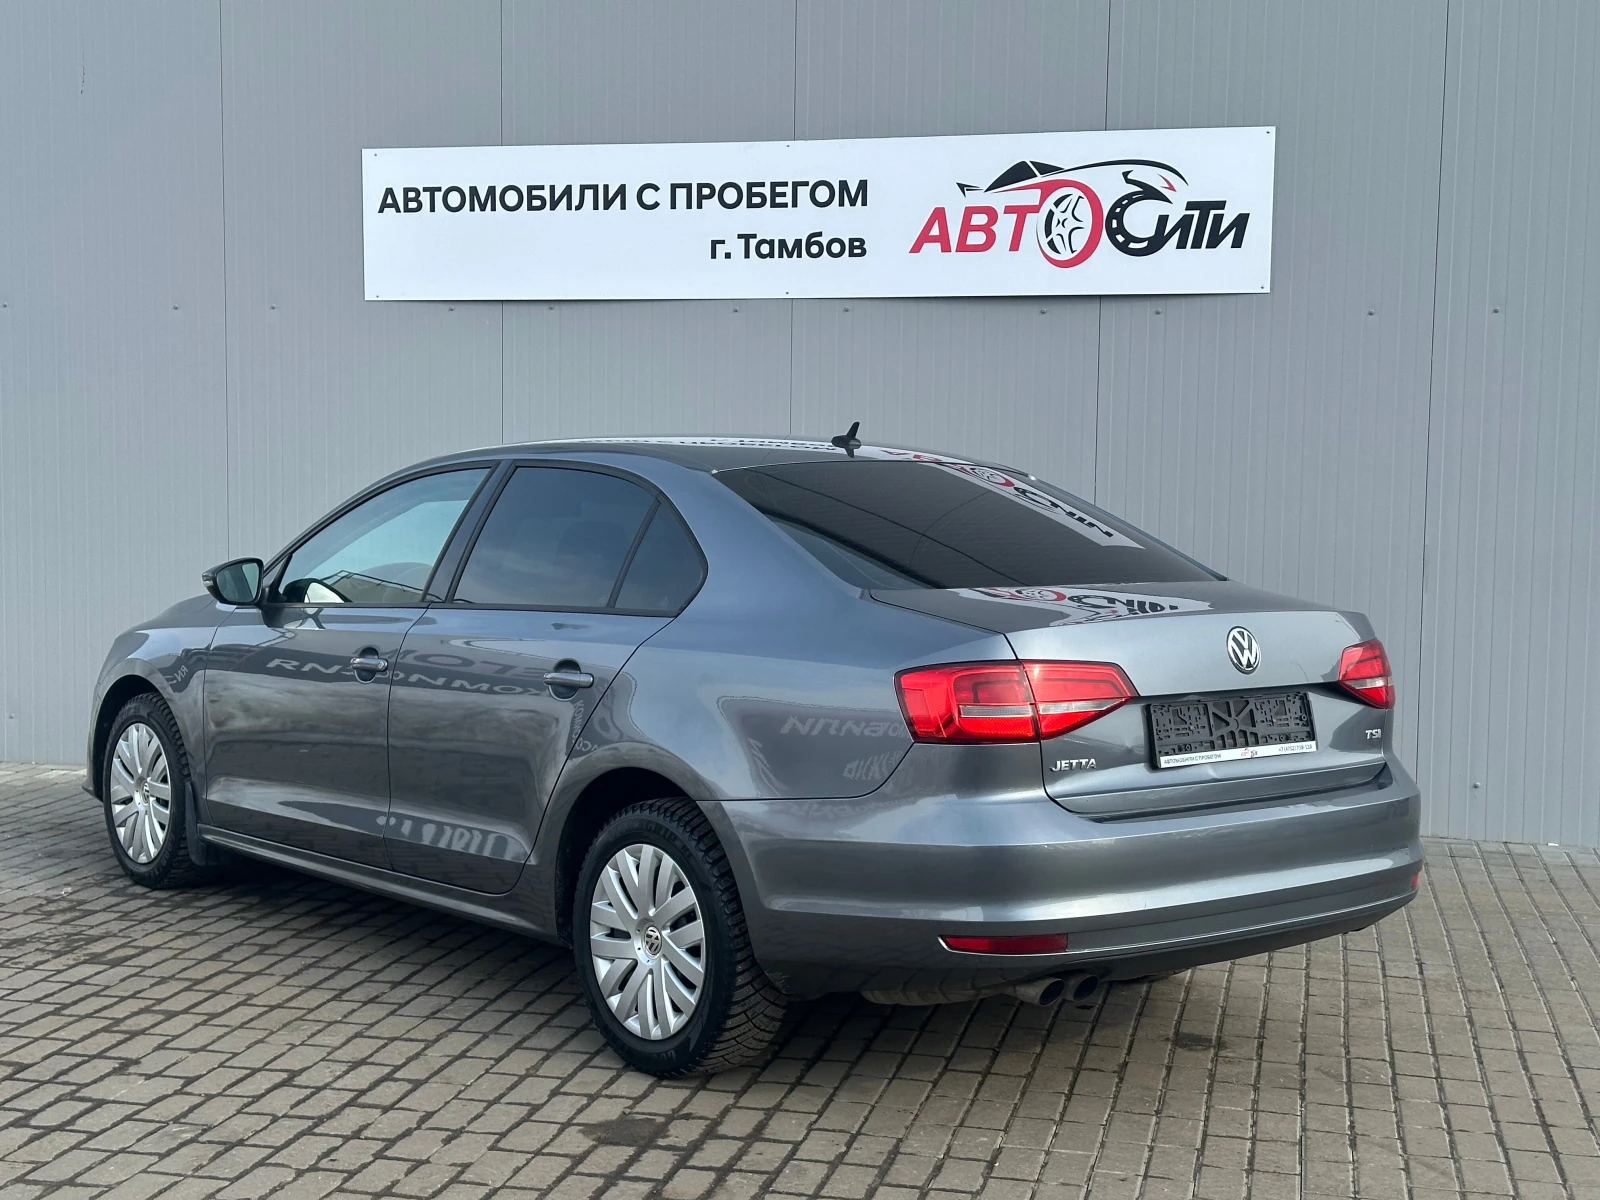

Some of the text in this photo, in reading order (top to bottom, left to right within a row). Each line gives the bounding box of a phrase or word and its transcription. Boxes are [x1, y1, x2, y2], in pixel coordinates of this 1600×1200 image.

[377, 179, 869, 214] АВТОМОБИЛИ С ПРОБЕГОМ
[710, 231, 867, 259] г. Тамбов
[1365, 728, 1382, 740] TSI
[1049, 758, 1097, 772] JETTA
